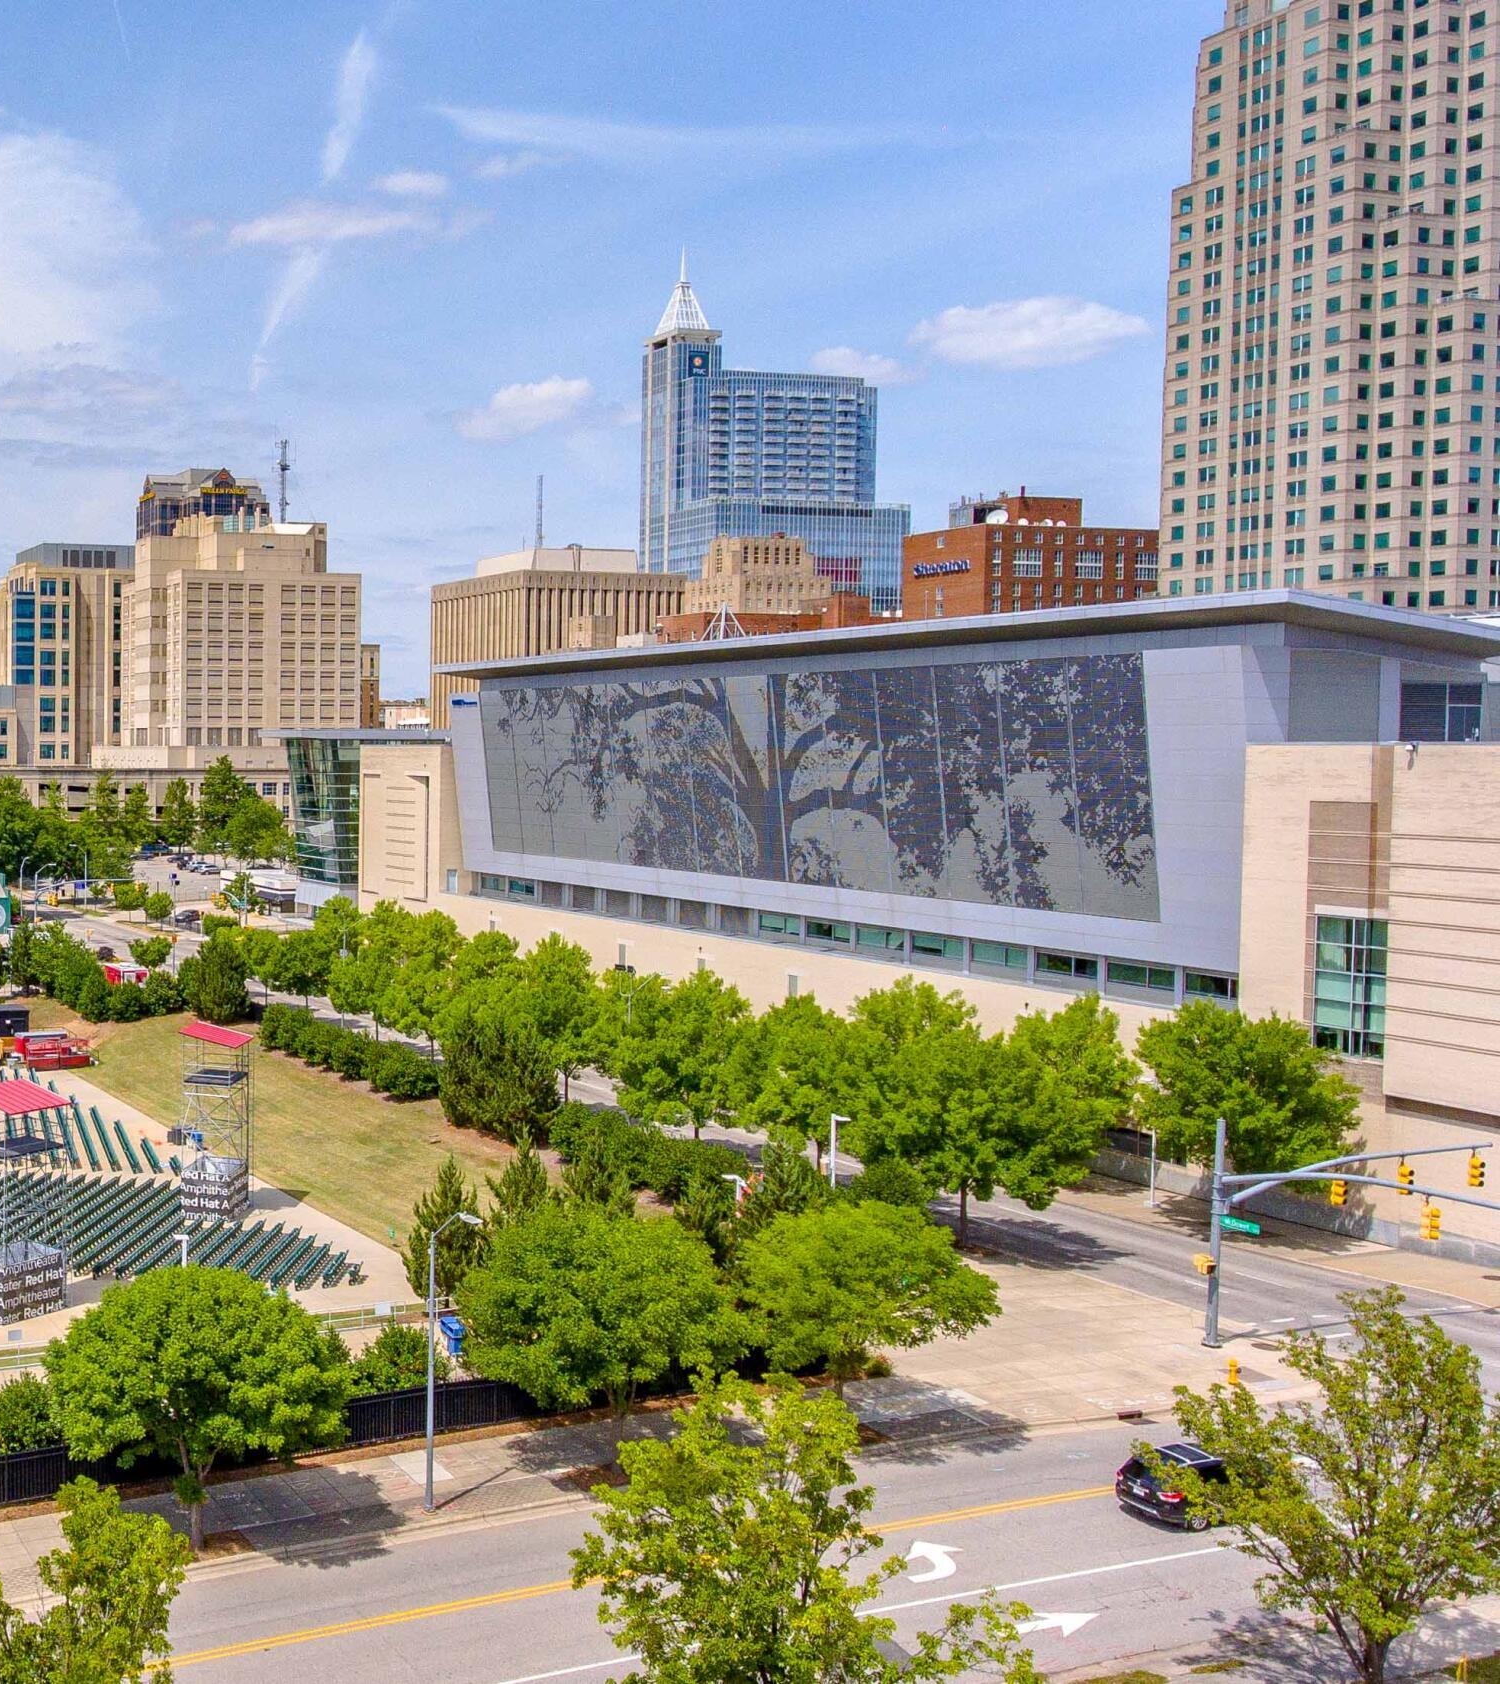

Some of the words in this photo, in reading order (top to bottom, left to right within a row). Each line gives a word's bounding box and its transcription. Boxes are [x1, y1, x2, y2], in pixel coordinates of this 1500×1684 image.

[913, 559, 971, 576] Sheraton
[201, 1197, 220, 1210] Hat
[25, 1273, 44, 1288] Red
[45, 1266, 65, 1282] Hat
[23, 1305, 45, 1320] Red
